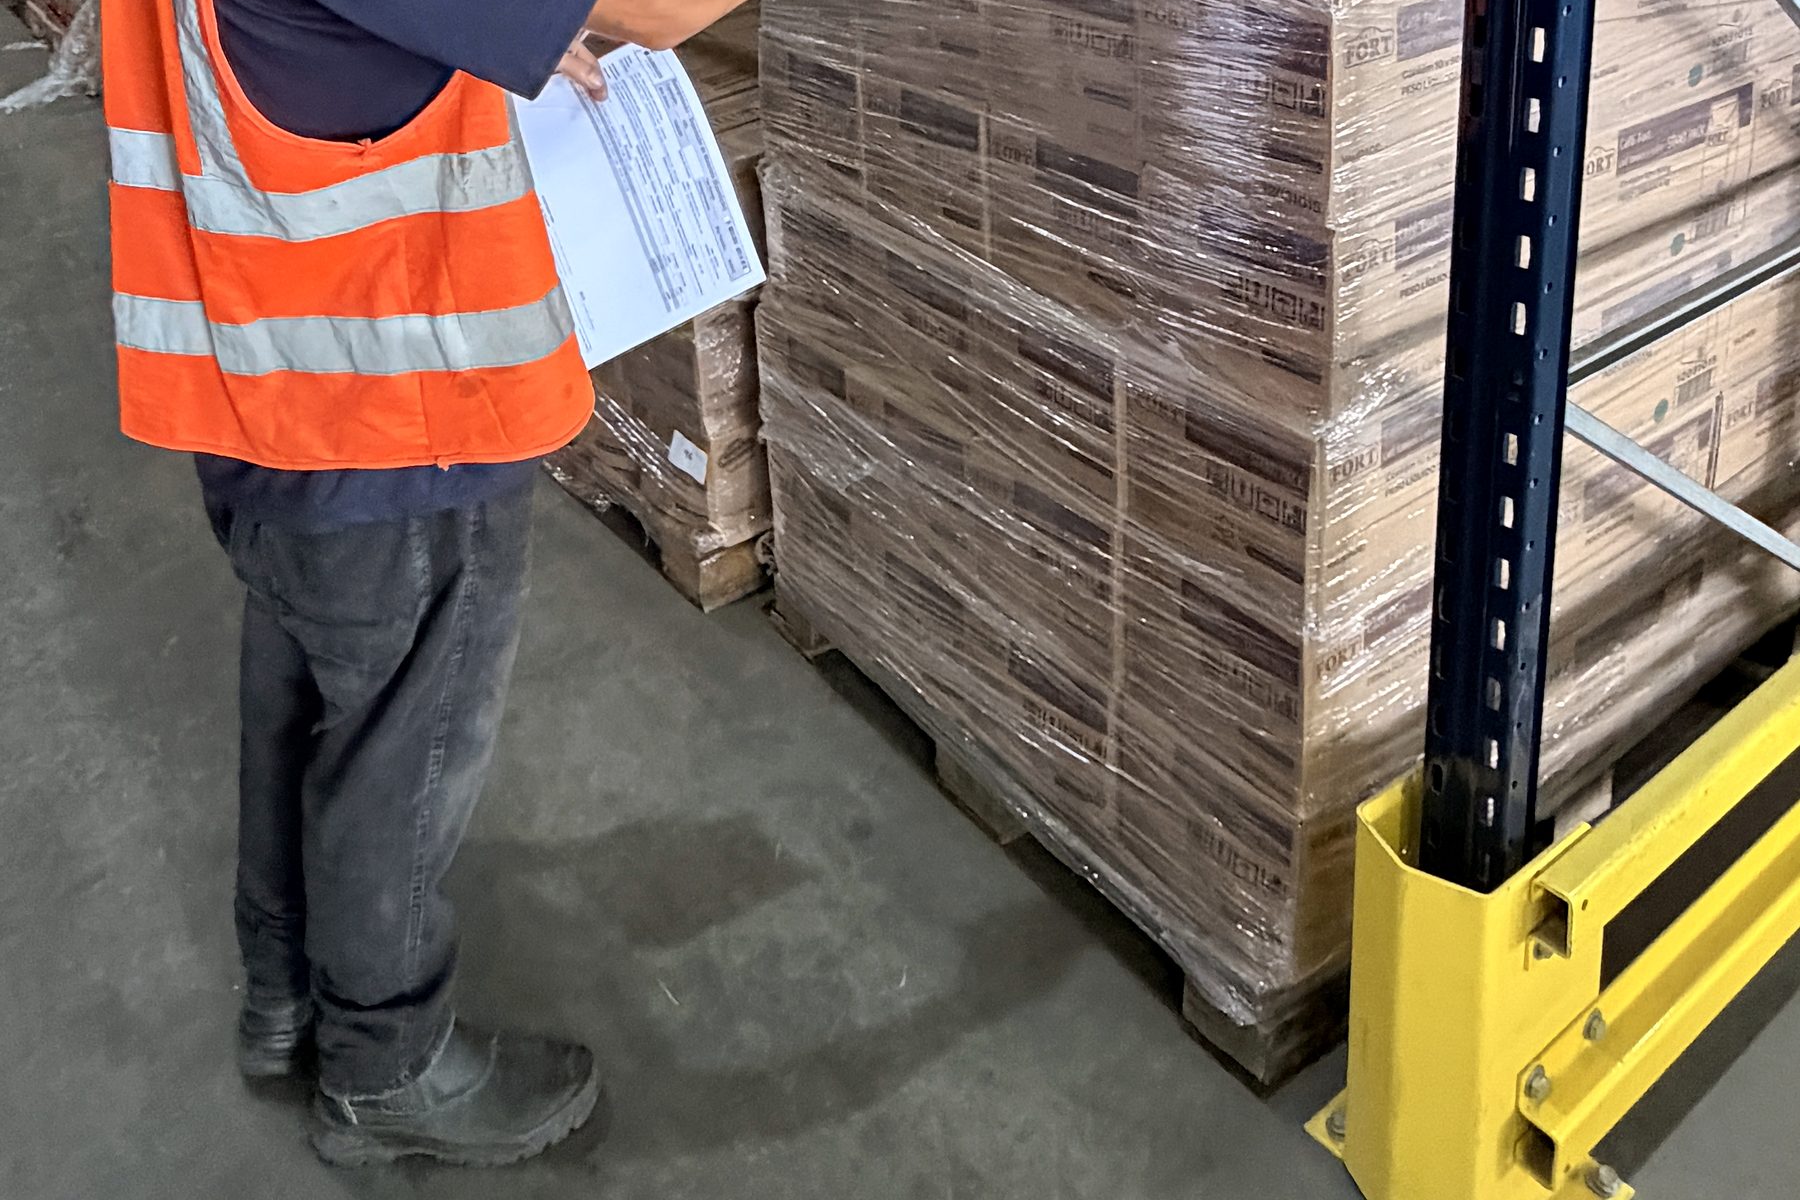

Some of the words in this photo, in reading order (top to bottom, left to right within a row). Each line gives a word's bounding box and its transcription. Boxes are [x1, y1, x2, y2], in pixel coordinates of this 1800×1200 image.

[1344, 36, 1392, 66] FORT
[1586, 155, 1613, 176] ORT
[1331, 449, 1376, 483] FORT
